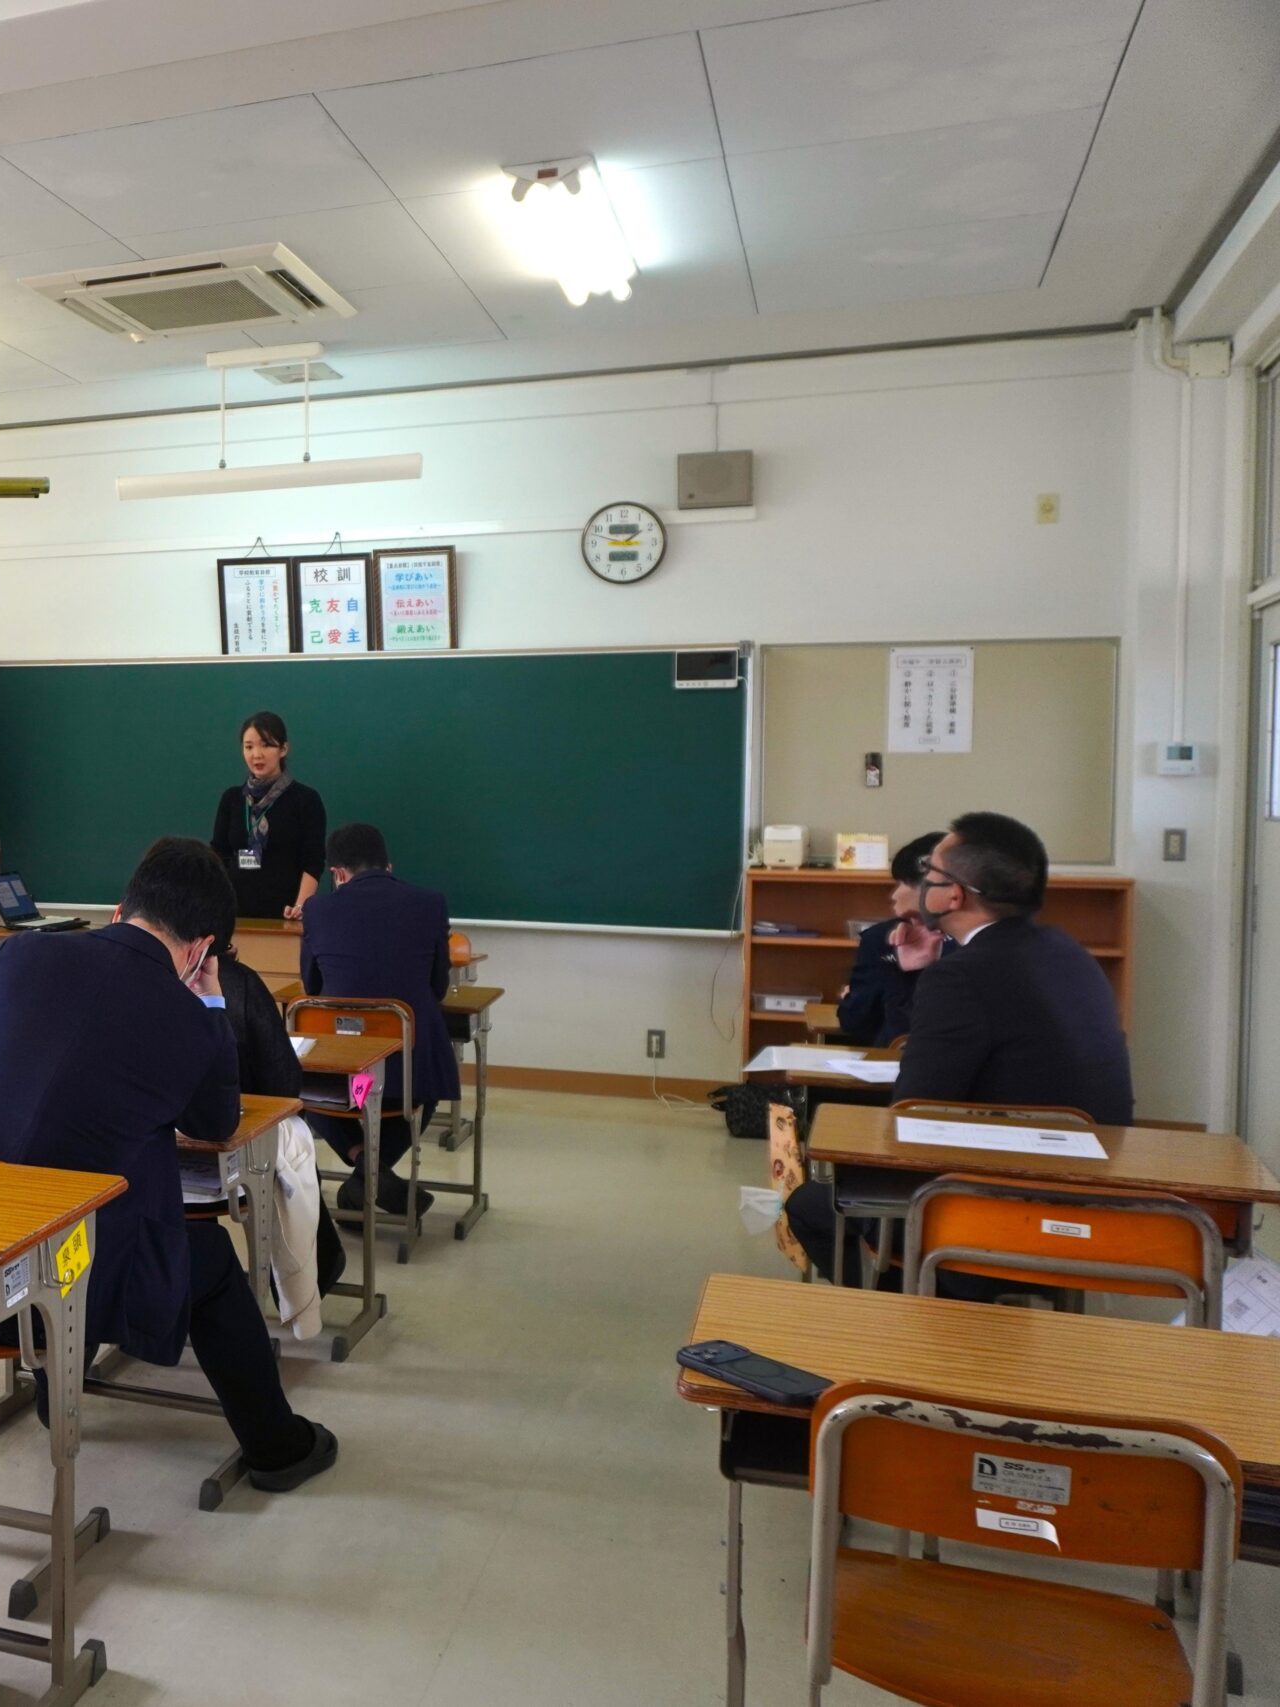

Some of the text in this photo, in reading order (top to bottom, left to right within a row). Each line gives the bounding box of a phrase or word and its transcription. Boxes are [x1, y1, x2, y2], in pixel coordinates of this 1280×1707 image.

[606, 513, 613, 522] 11
[620, 509, 629, 518] 12
[594, 524, 603, 533] 10
[313, 567, 351, 583] 校訓
[326, 597, 342, 645] 友愛
[346, 597, 361, 644] 自主
